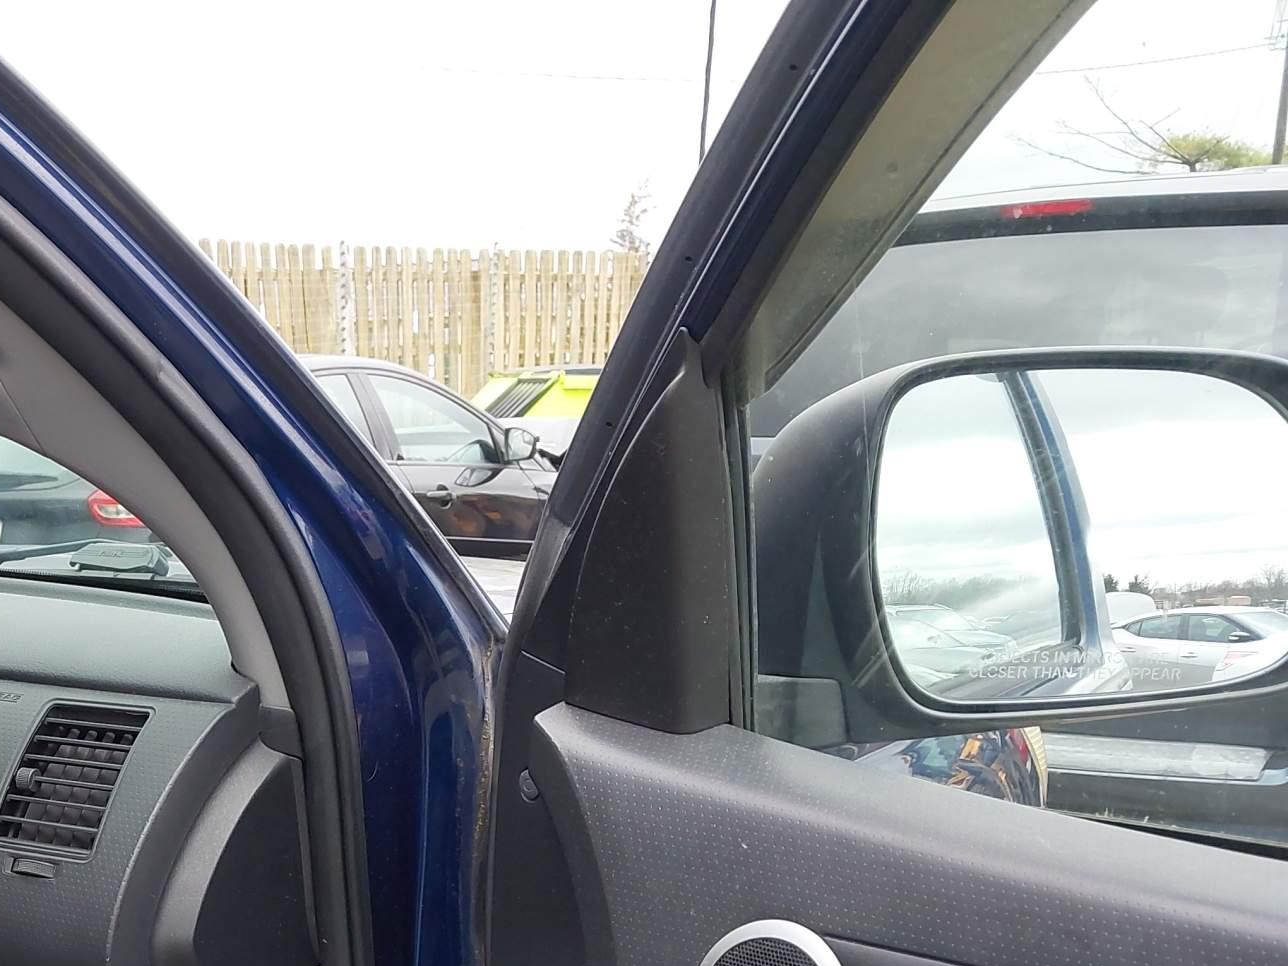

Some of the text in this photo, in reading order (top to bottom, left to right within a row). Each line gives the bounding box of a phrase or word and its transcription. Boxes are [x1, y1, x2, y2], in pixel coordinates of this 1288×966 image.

[968, 665, 1028, 679] CLOSER
[1031, 665, 1074, 679] THAN
[1121, 667, 1183, 680] PPEAR
